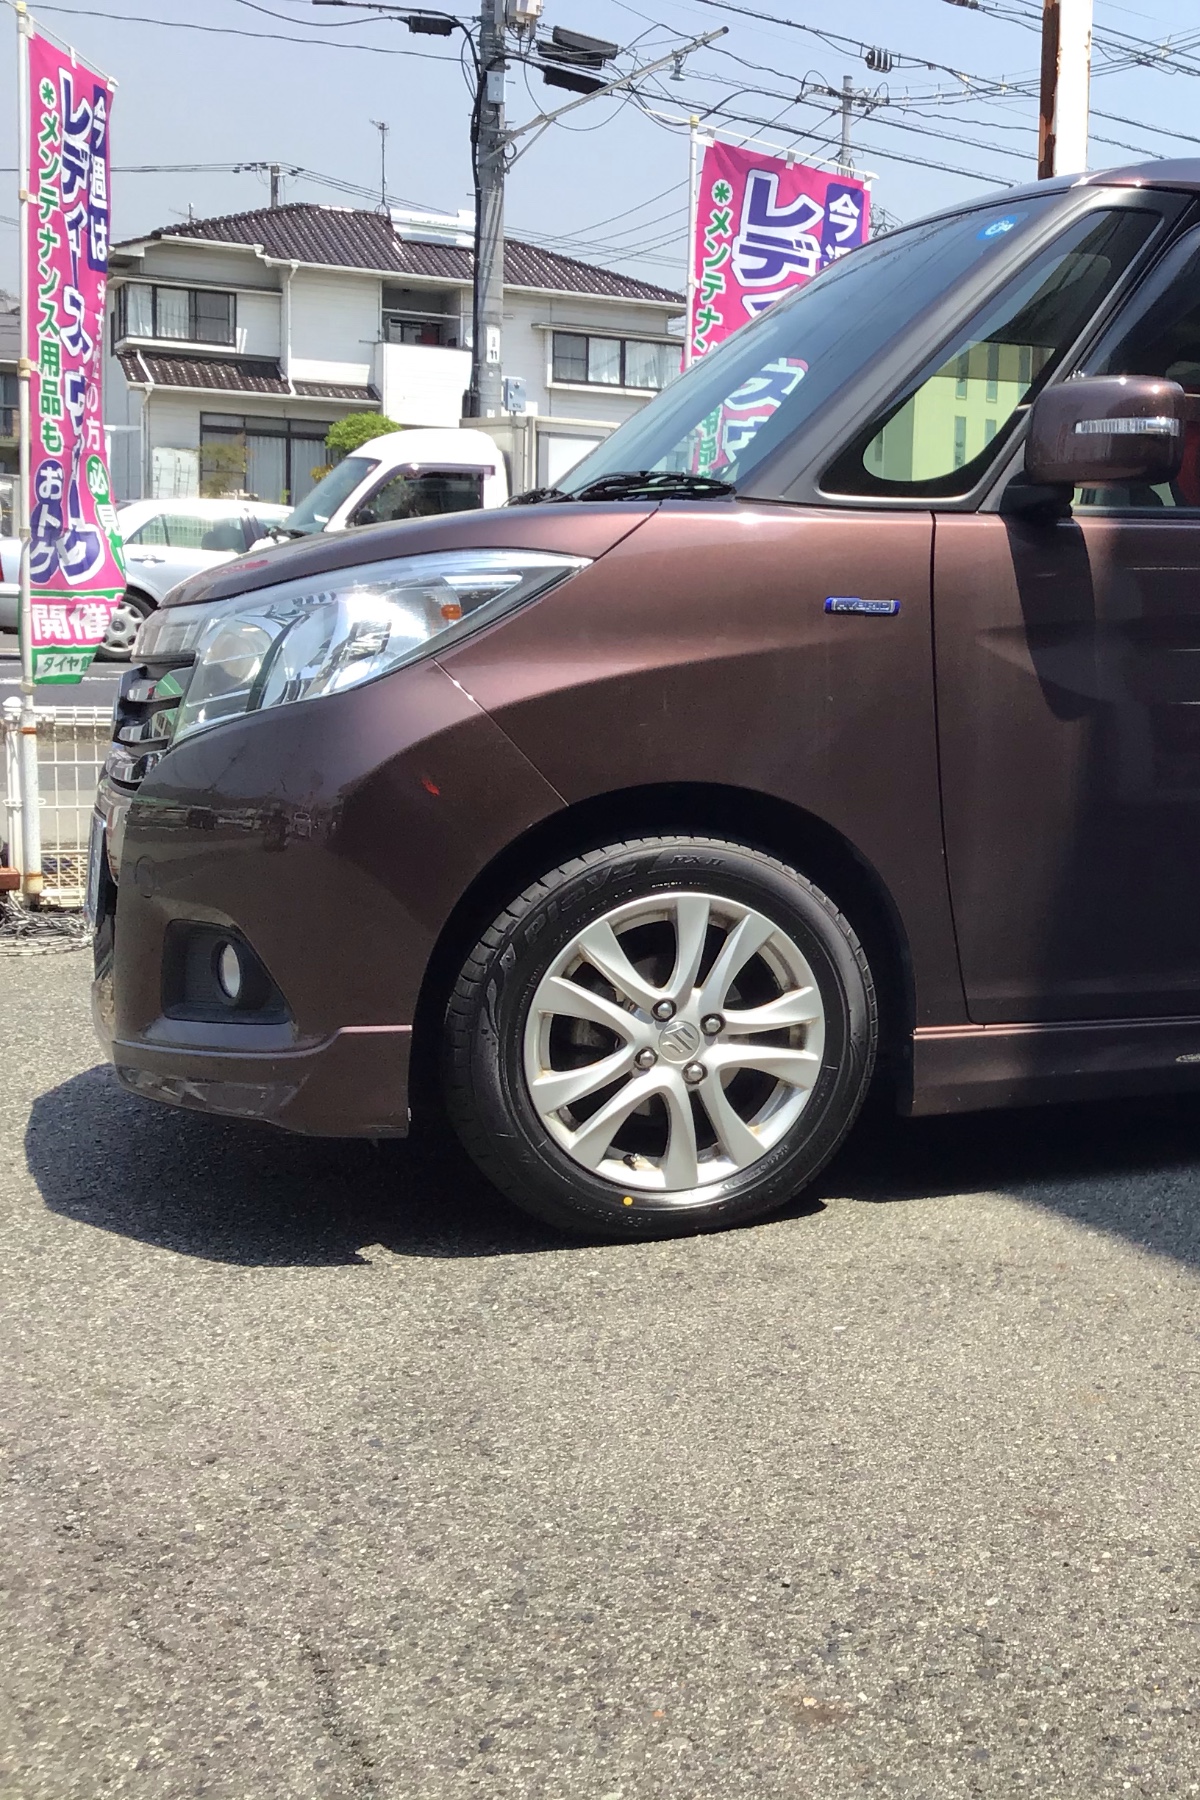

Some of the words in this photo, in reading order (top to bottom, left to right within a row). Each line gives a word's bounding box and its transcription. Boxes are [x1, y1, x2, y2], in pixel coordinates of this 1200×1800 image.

[89, 96, 108, 261] 今週は
[31, 603, 113, 641] 開催
